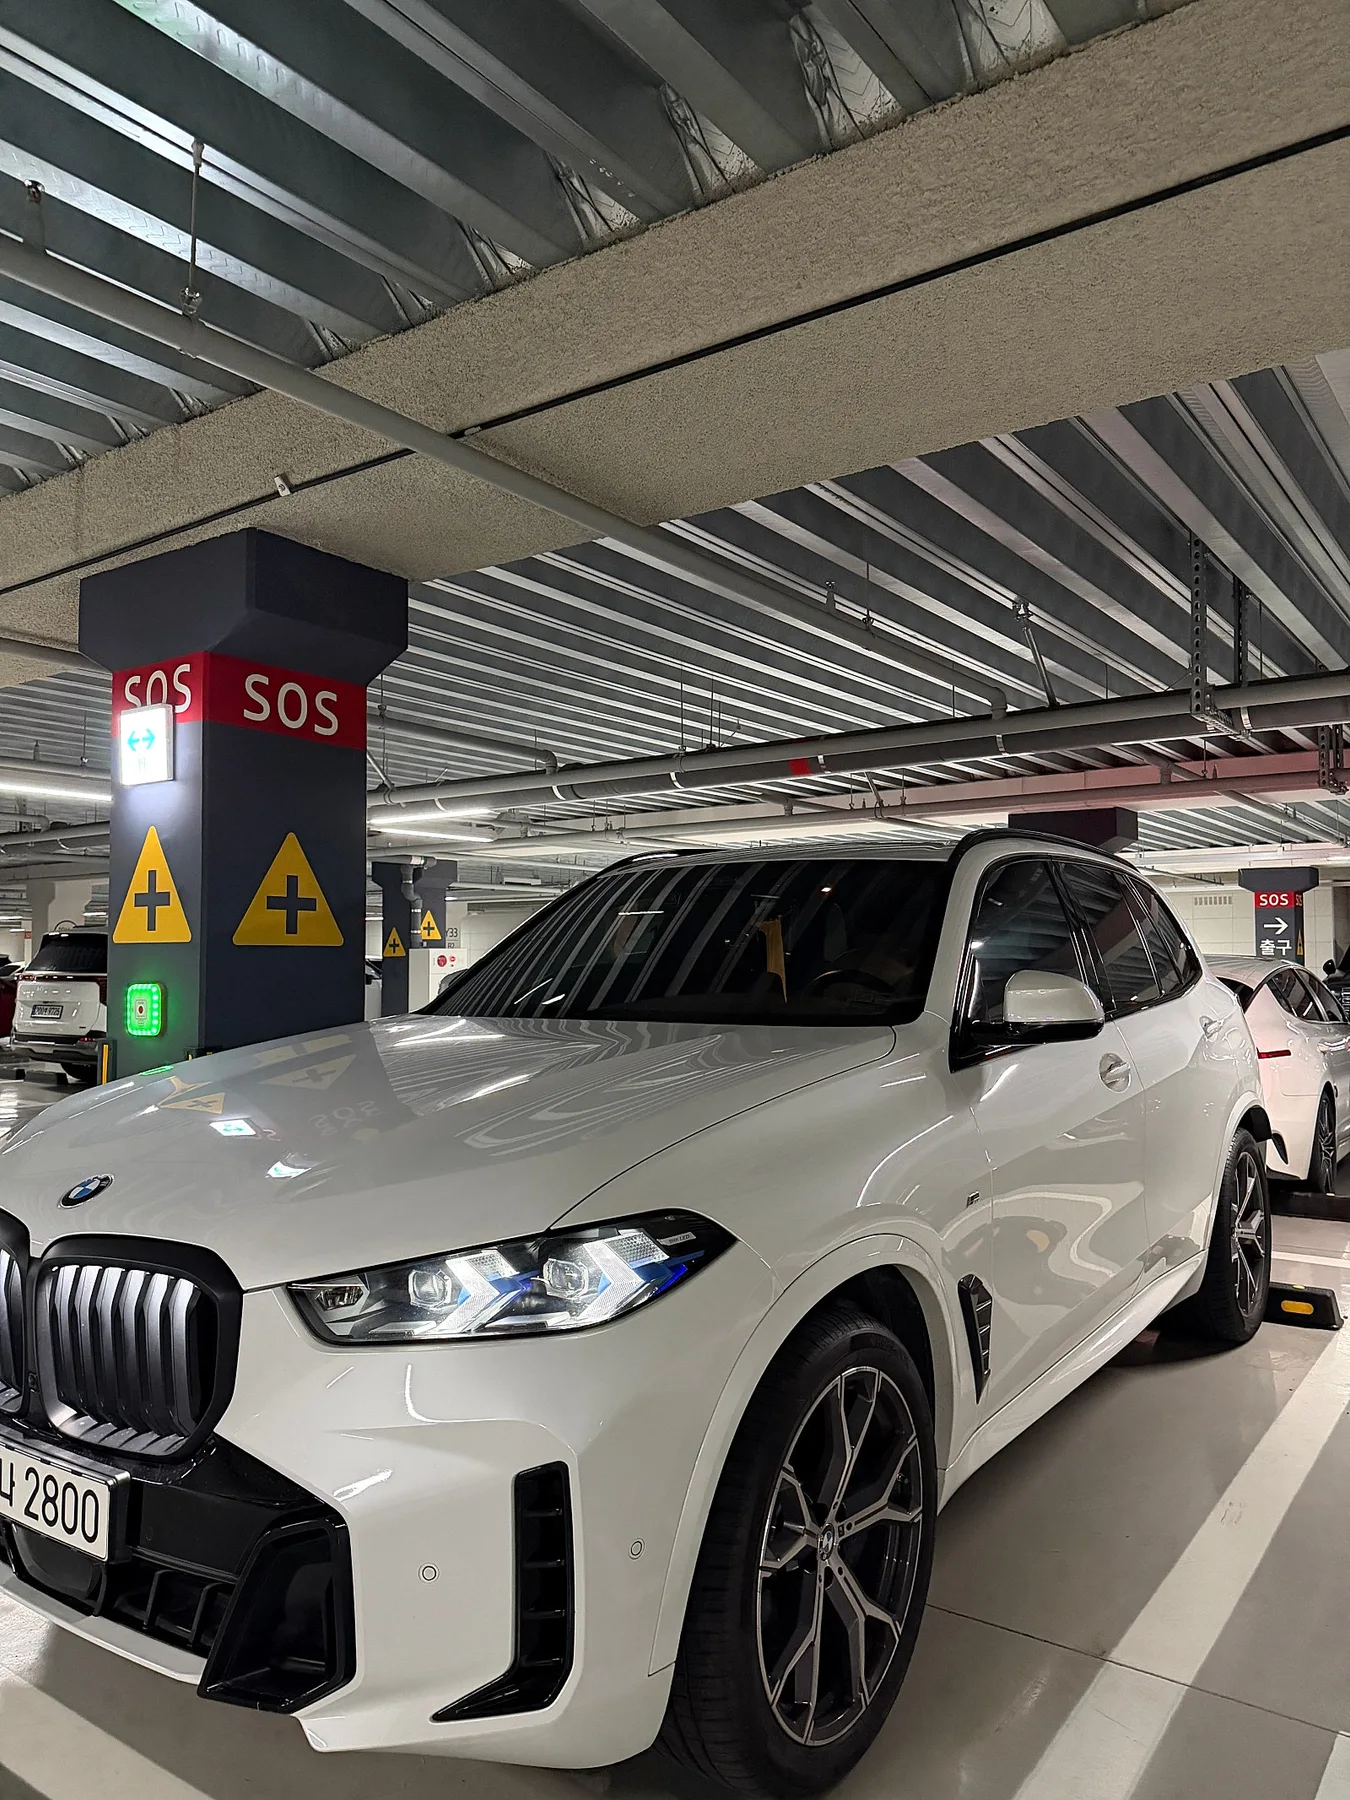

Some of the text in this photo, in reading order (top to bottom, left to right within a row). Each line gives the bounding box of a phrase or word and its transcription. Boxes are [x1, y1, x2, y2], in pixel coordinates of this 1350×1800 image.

[124, 663, 191, 713] SOS
[243, 673, 338, 736] SOS
[1259, 893, 1289, 906] SOS
[1259, 938, 1292, 956] 출구
[24, 1466, 99, 1544] 2800
